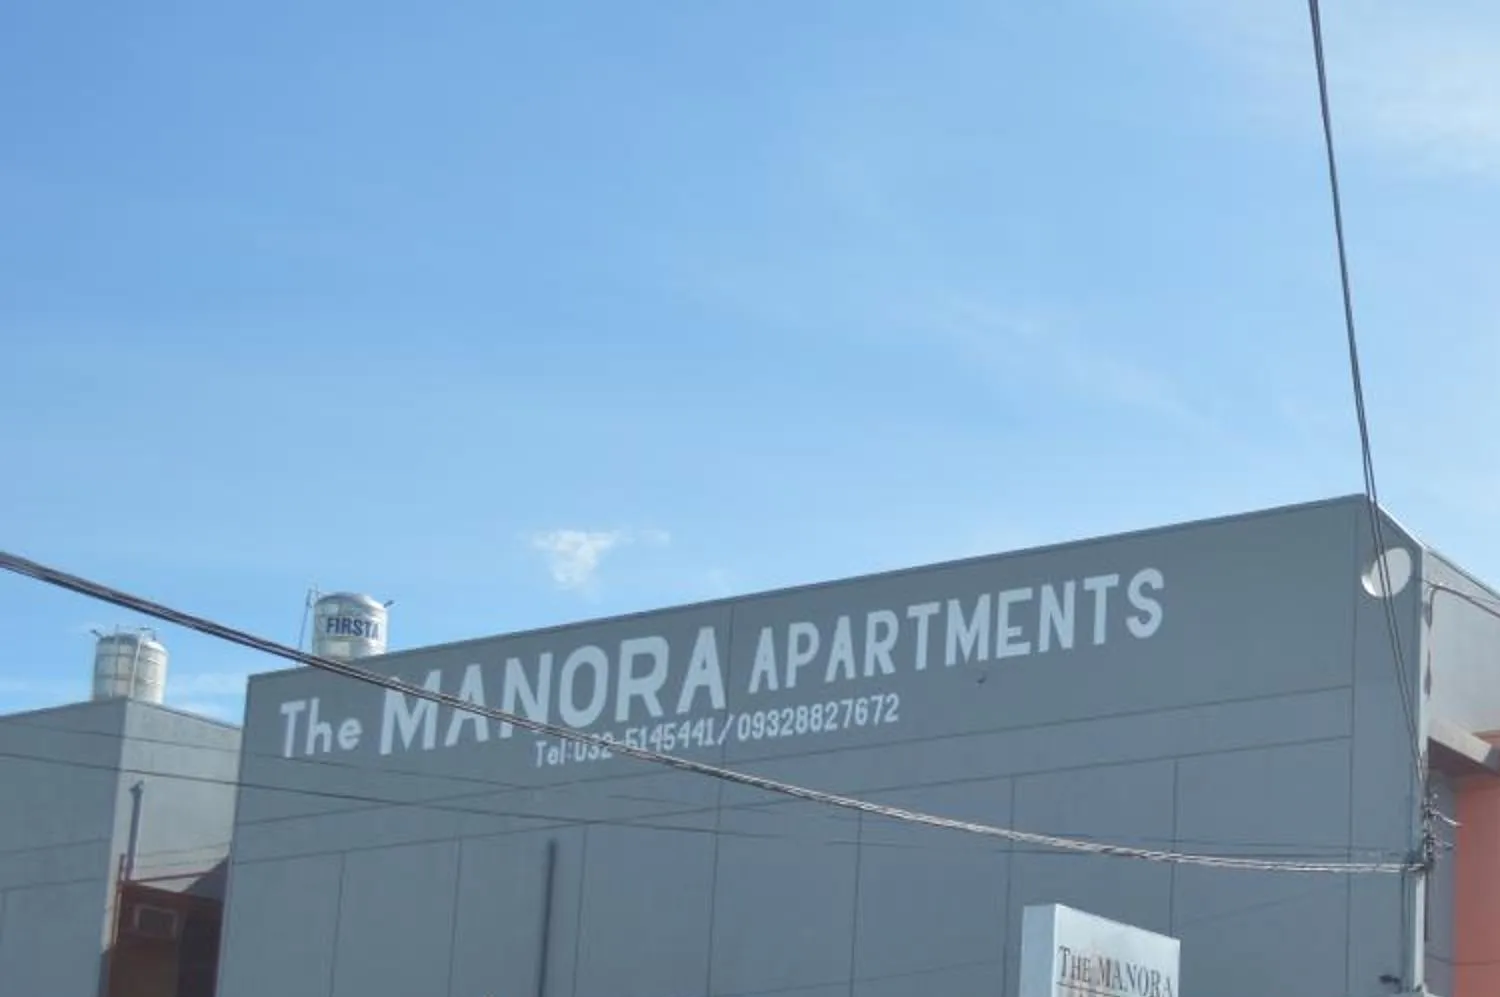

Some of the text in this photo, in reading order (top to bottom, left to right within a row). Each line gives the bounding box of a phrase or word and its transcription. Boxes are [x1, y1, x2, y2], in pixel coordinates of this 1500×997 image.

[281, 567, 1165, 759] The MANORA APARTMENTS
